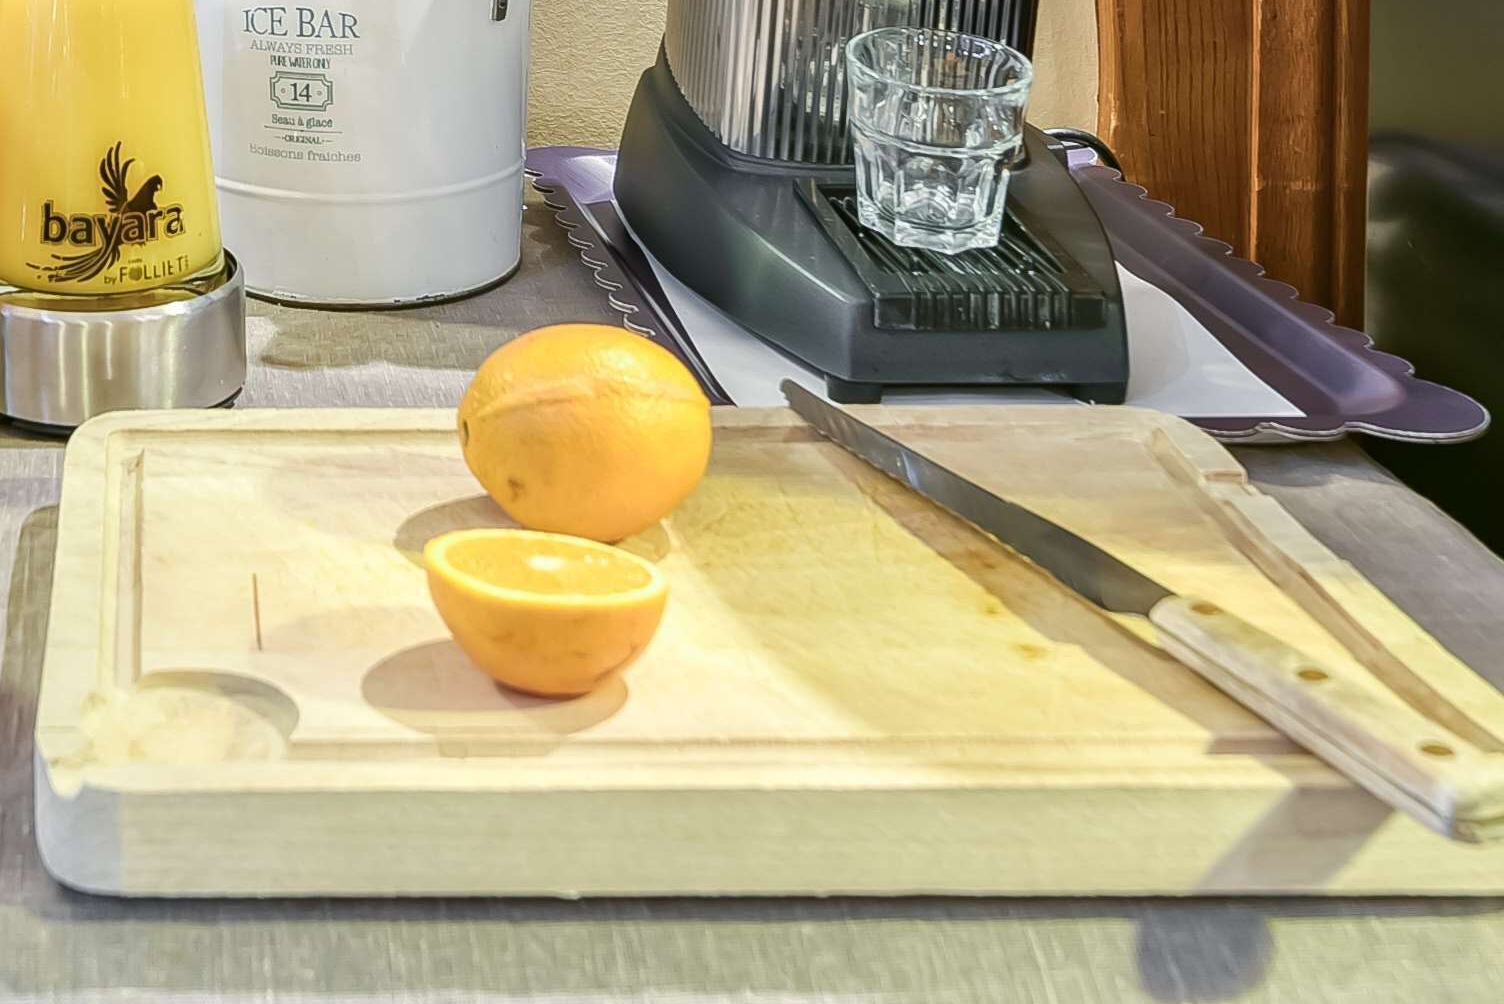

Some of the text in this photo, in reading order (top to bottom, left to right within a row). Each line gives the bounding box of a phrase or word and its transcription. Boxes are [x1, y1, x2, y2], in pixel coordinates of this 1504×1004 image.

[243, 7, 360, 39] ICE BAR
[250, 39, 354, 56] ALWAYS FRESH
[270, 56, 331, 70] PURE WATER ONLY
[290, 82, 312, 102] 14
[271, 113, 333, 129] Seau à glace
[41, 199, 186, 248] bayara
